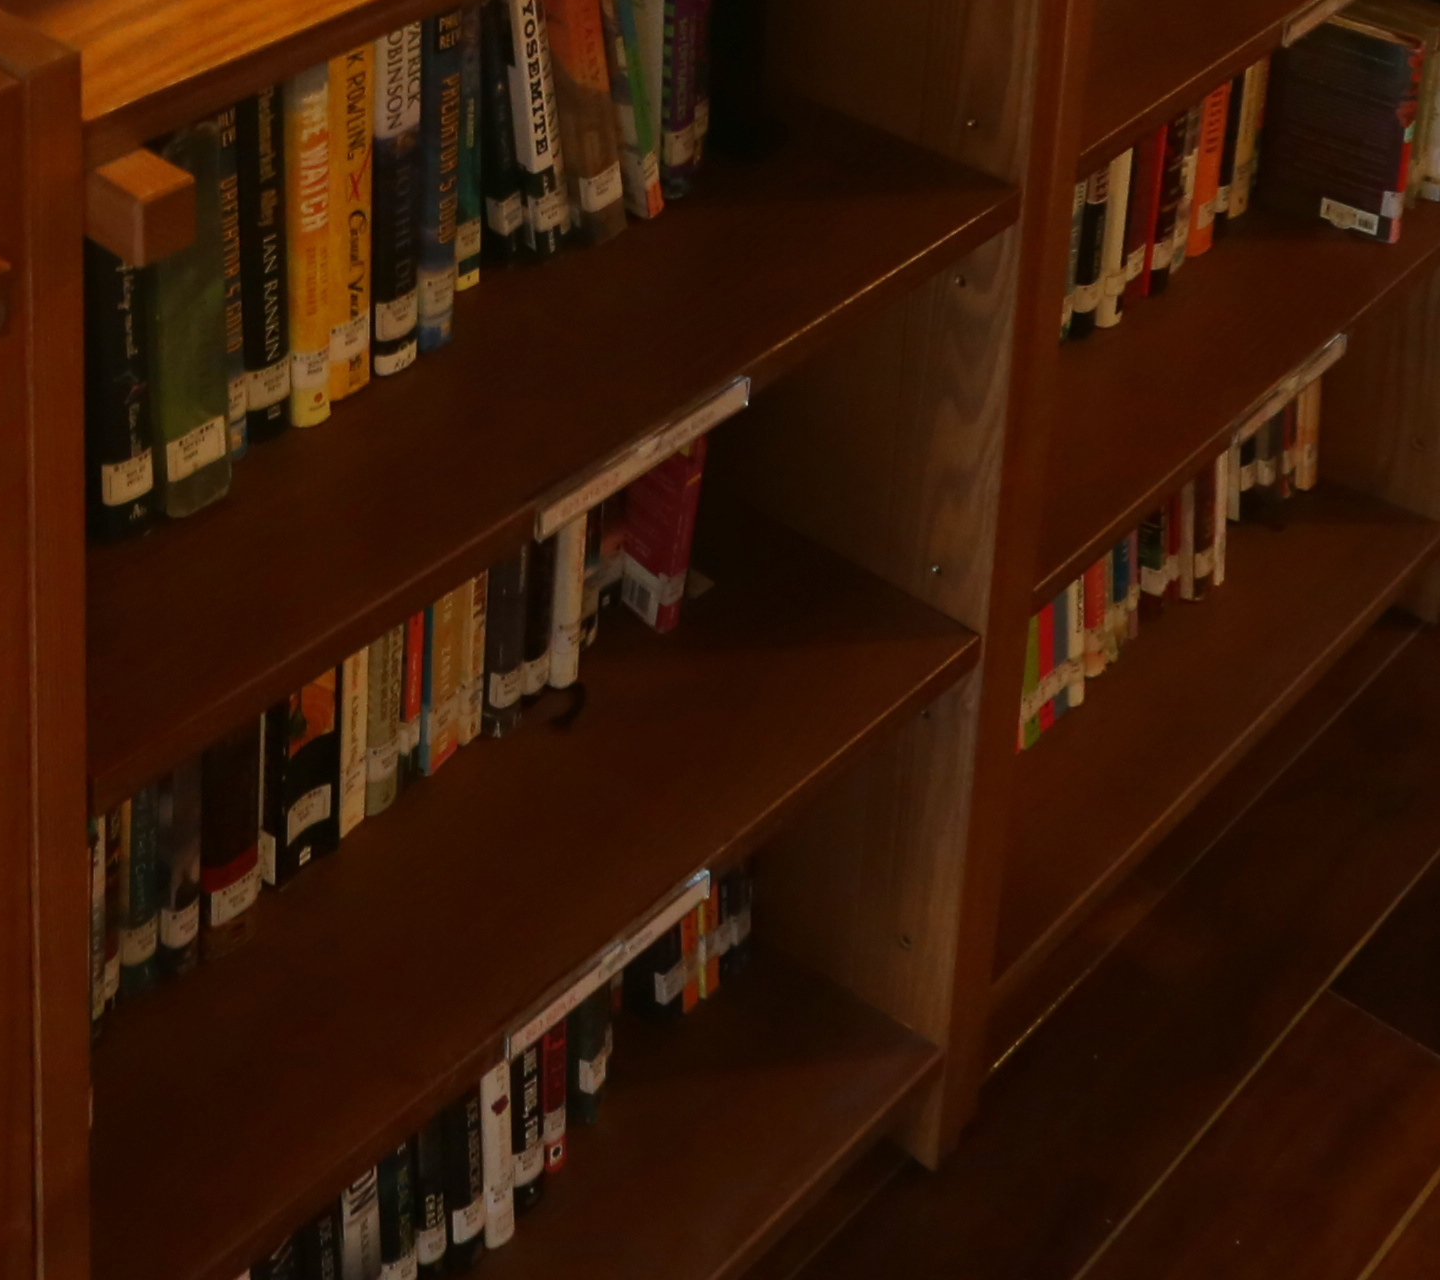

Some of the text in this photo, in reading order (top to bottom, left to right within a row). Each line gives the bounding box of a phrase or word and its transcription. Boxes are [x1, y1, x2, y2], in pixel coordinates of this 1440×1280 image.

[298, 86, 330, 233] THE WATCH
[344, 71, 366, 162] ROWLING
[261, 233, 279, 362] IAN RANKIN
